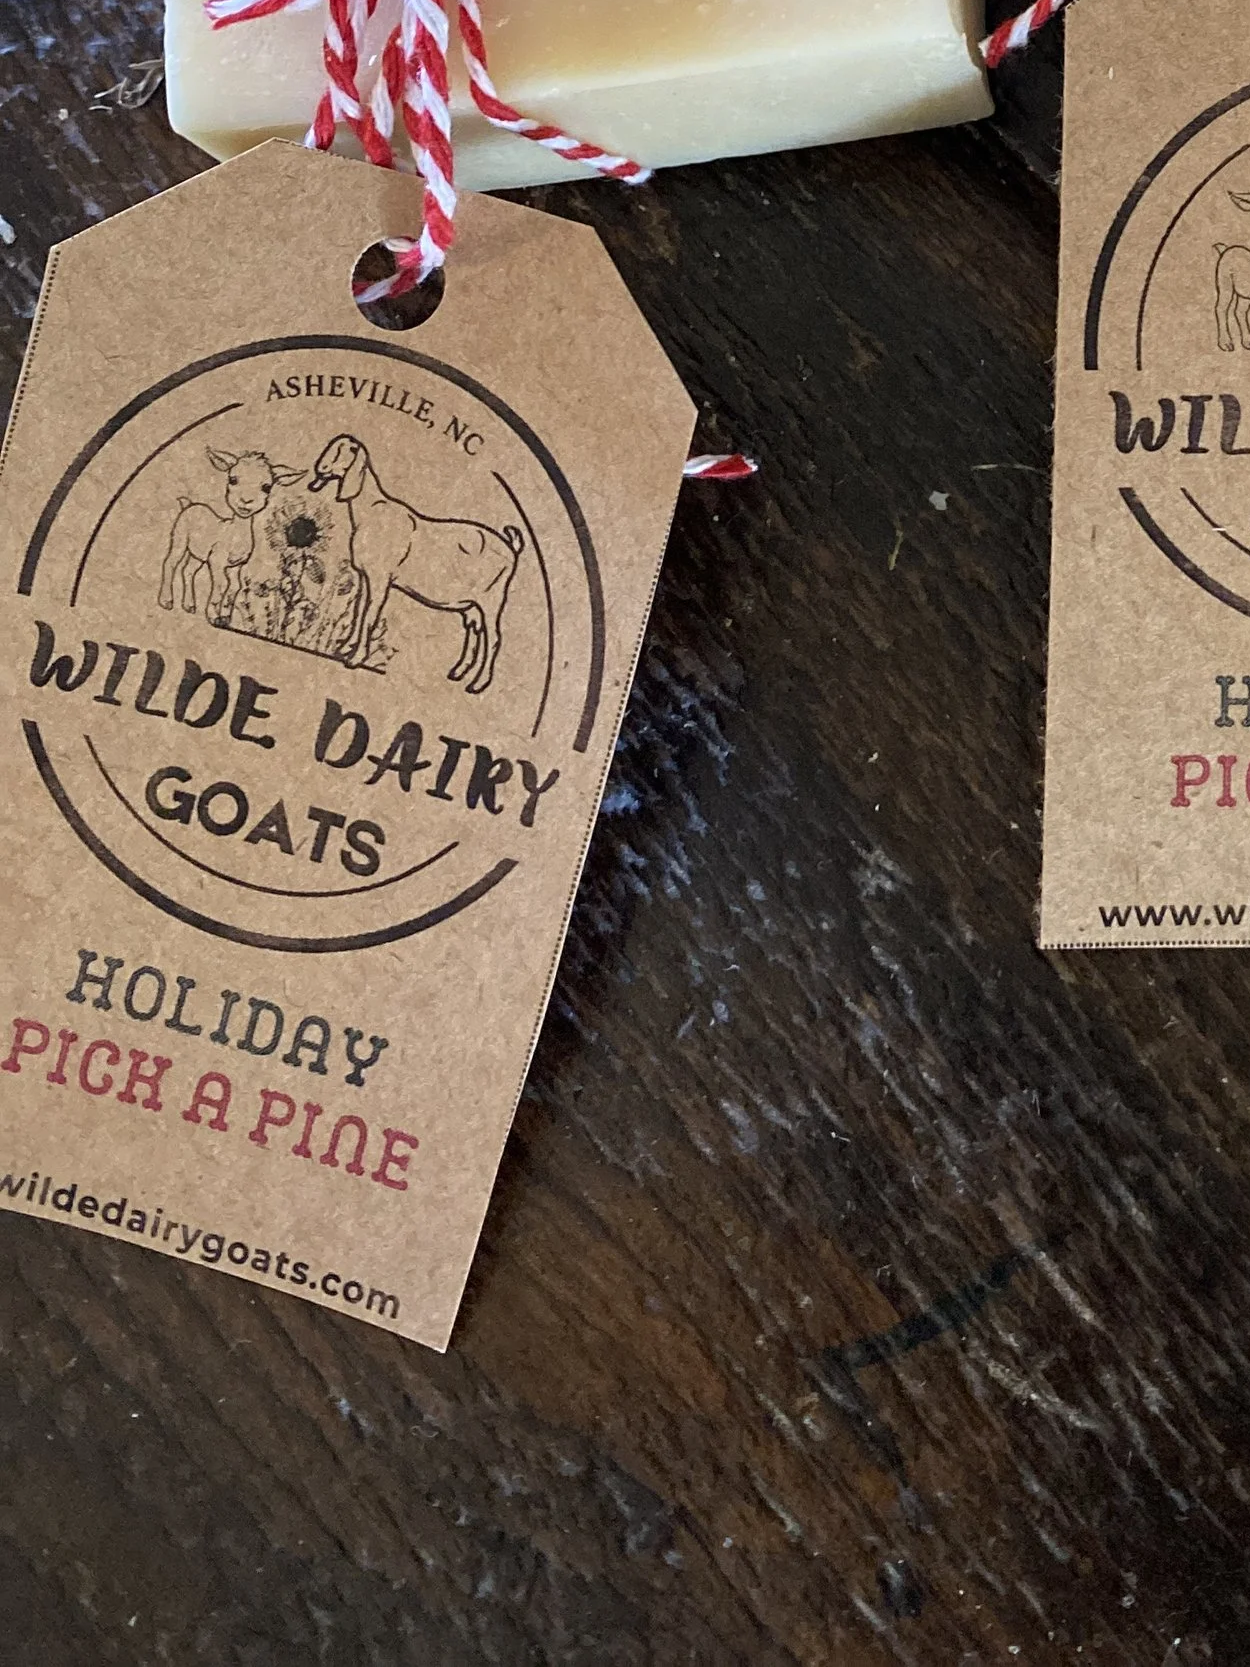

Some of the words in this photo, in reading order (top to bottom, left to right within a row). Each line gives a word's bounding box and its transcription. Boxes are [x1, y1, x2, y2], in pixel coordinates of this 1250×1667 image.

[266, 374, 435, 429] ASHEVILLE,
[443, 415, 484, 456] NC
[30, 619, 282, 752] WILDE
[315, 696, 560, 830] DAIRY
[144, 765, 387, 879] GOATS
[66, 948, 391, 1086] HOLIDAY
[1, 1018, 172, 1112] PICK
[182, 1070, 232, 1132] A
[249, 1089, 421, 1192] PINE
